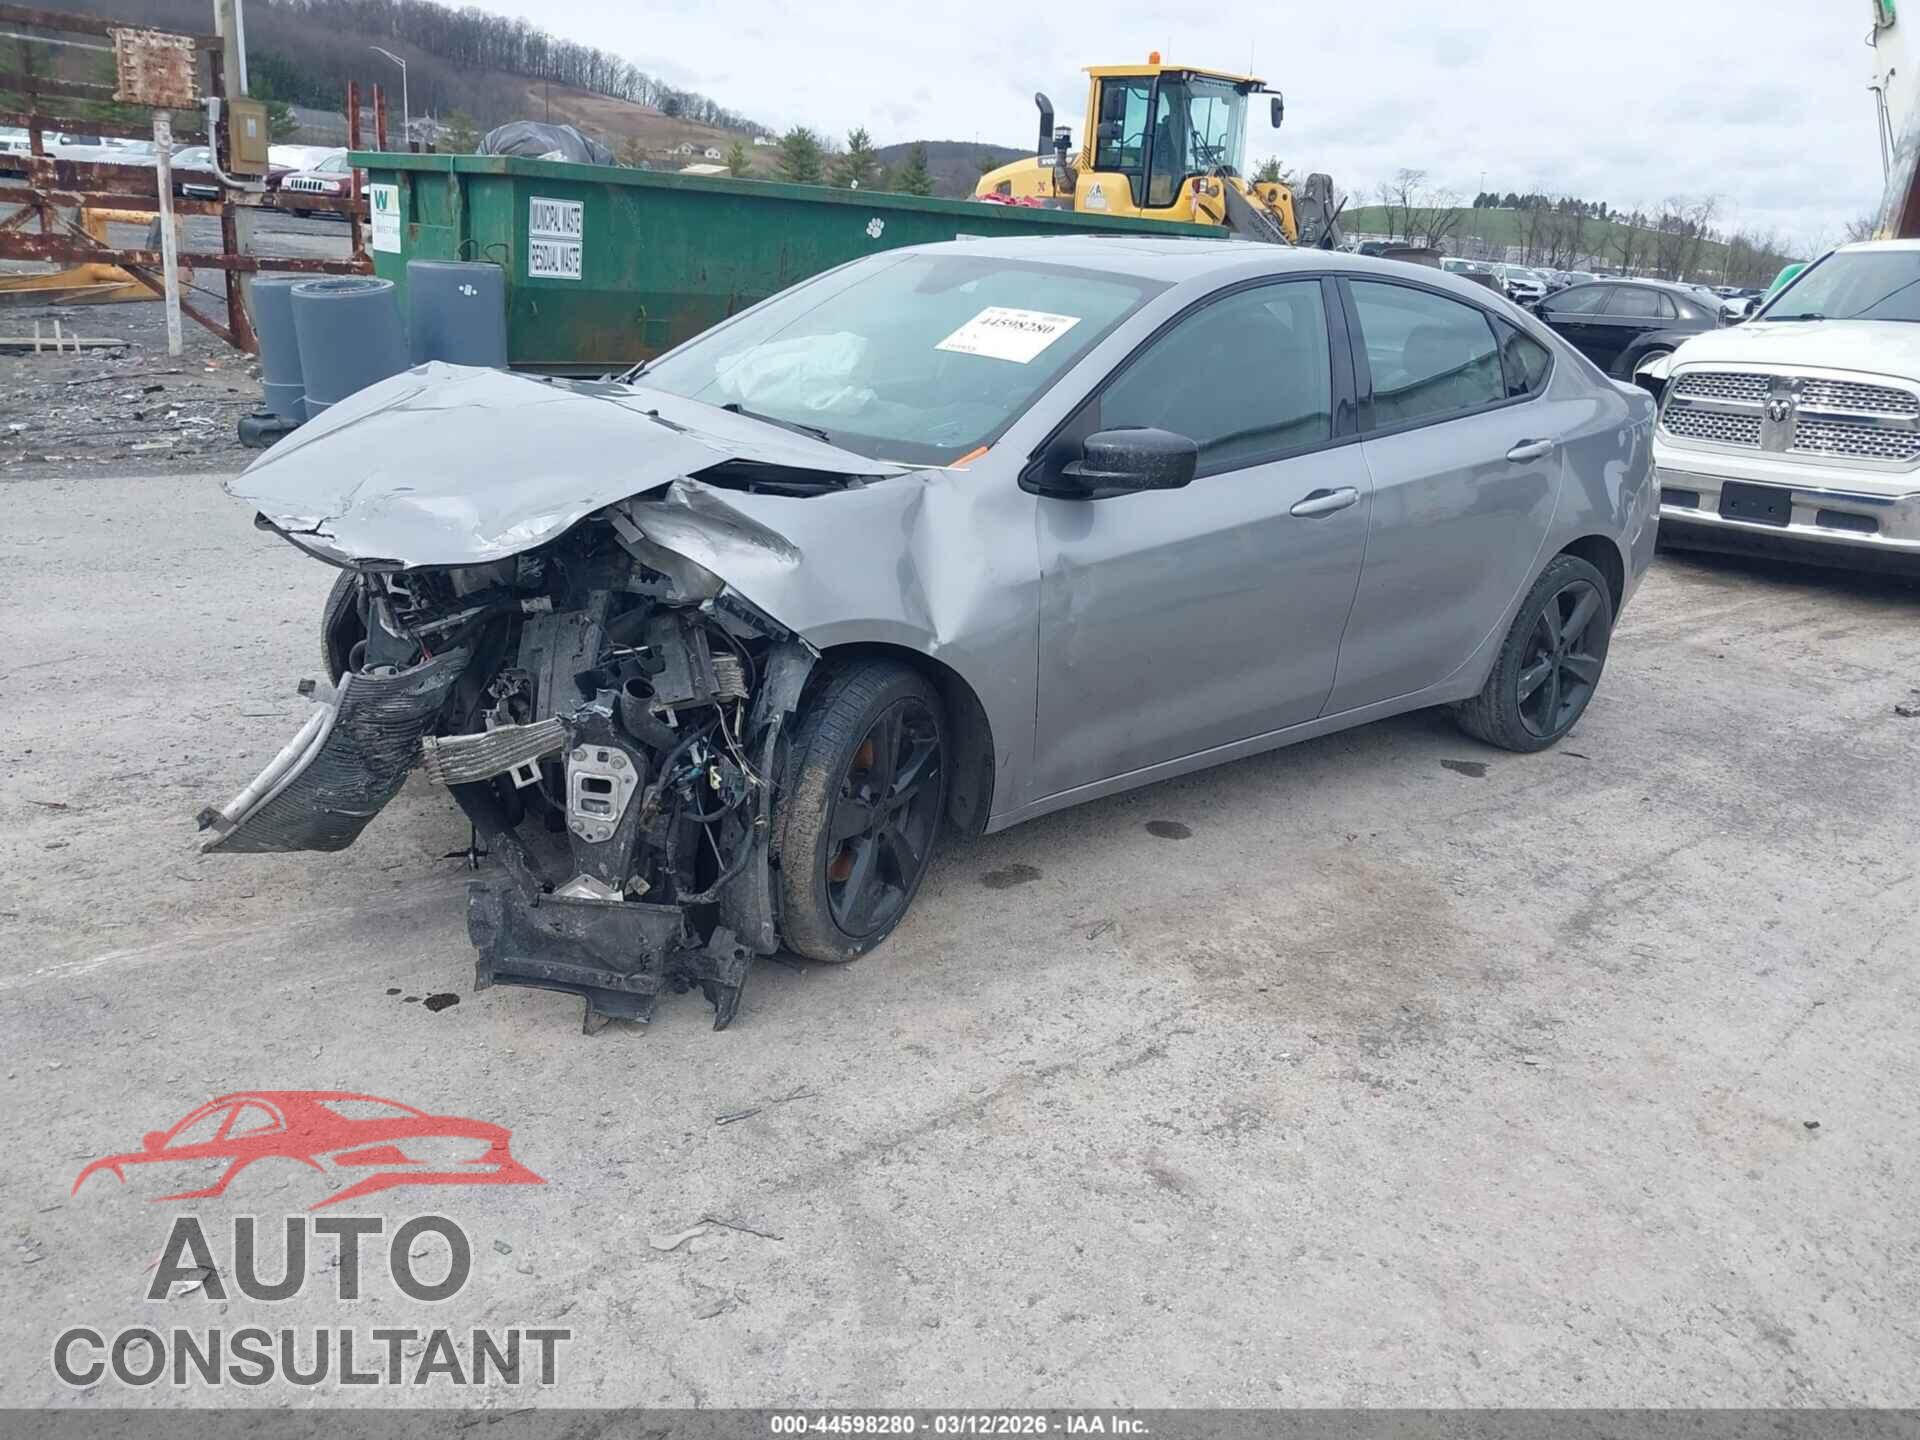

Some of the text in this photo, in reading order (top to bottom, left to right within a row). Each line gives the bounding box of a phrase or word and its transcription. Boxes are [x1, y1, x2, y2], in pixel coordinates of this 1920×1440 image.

[562, 206, 581, 234] WASTE
[532, 244, 580, 274] RESIDUAL WASTE
